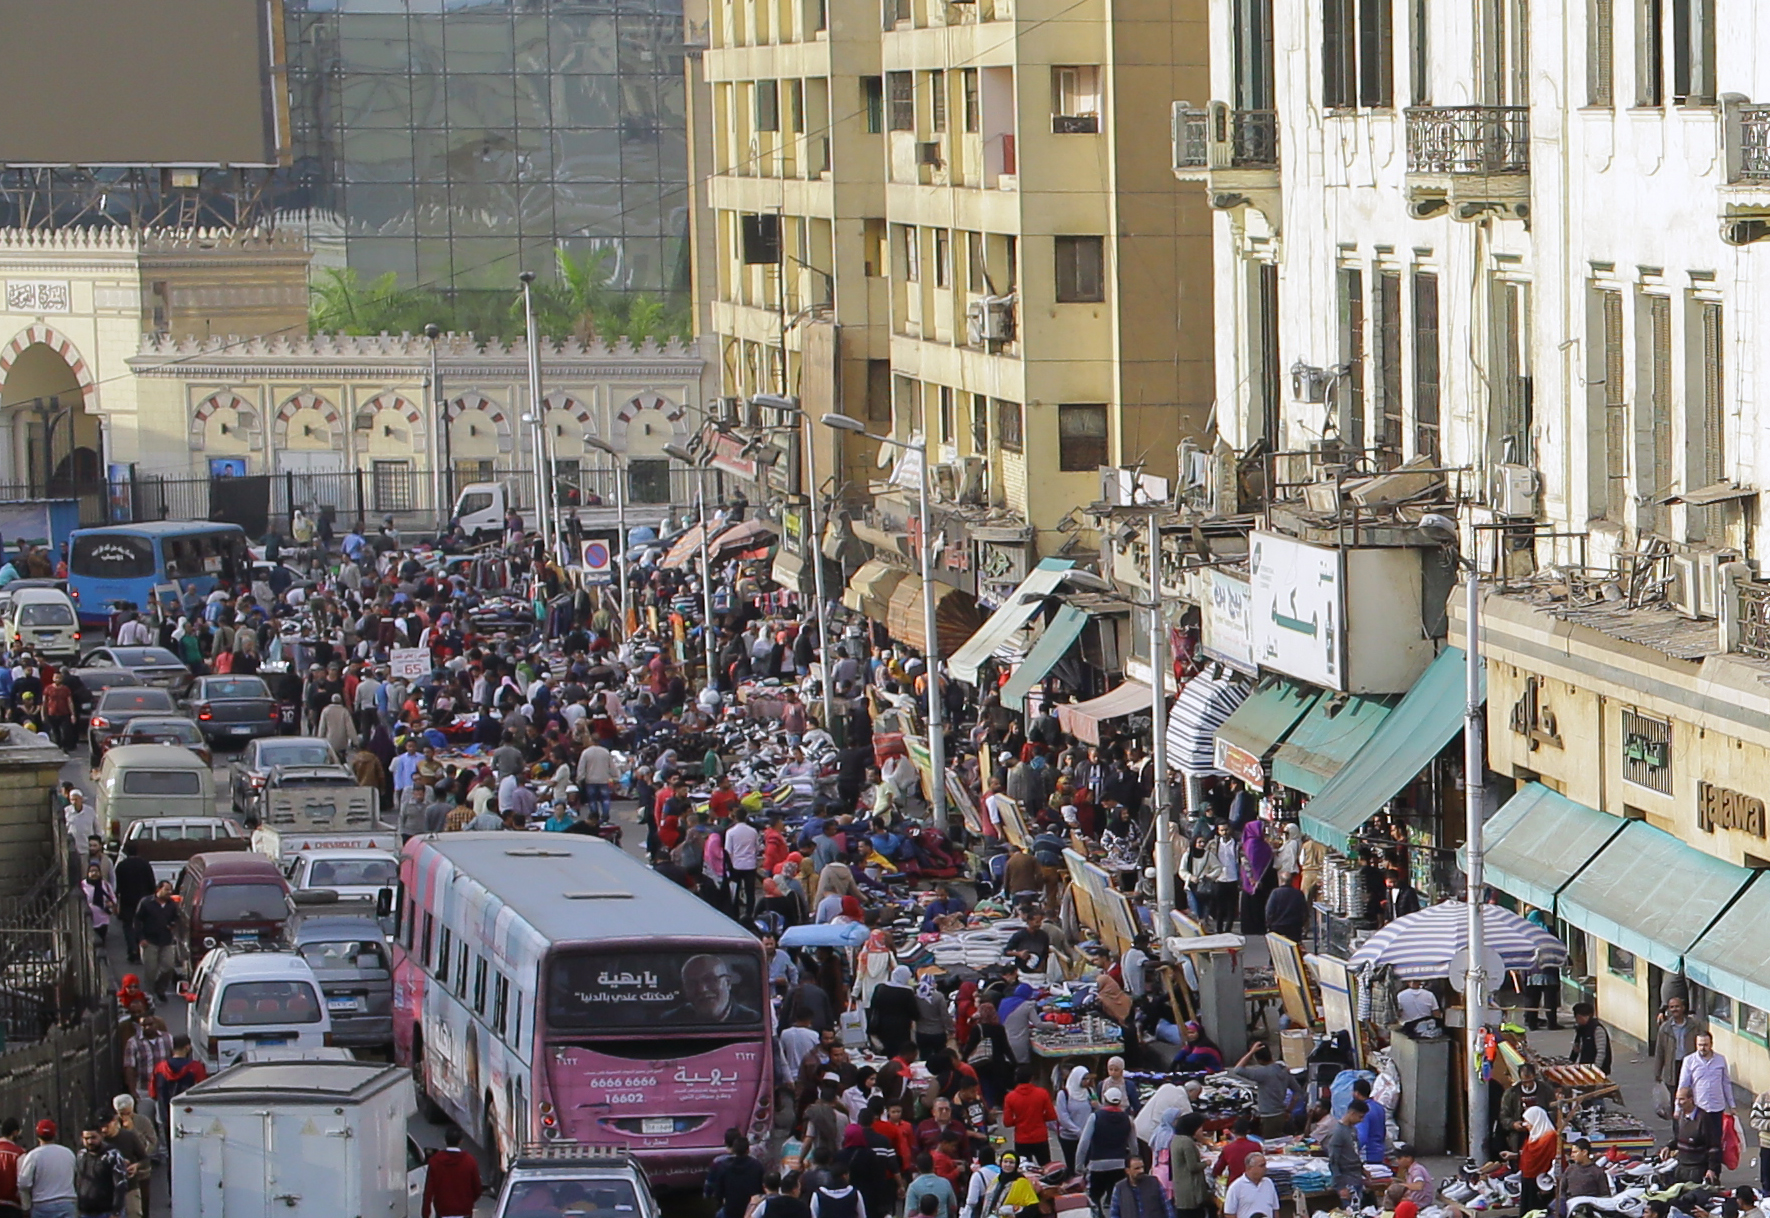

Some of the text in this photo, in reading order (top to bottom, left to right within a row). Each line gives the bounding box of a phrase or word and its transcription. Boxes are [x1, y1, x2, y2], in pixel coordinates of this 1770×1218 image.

[405, 664, 422, 674] 65
[1697, 780, 1766, 839] Halawa
[315, 840, 361, 849] CHEVROLET
[590, 1076, 657, 1088] 6666 6666
[605, 1093, 644, 1104] 16602
